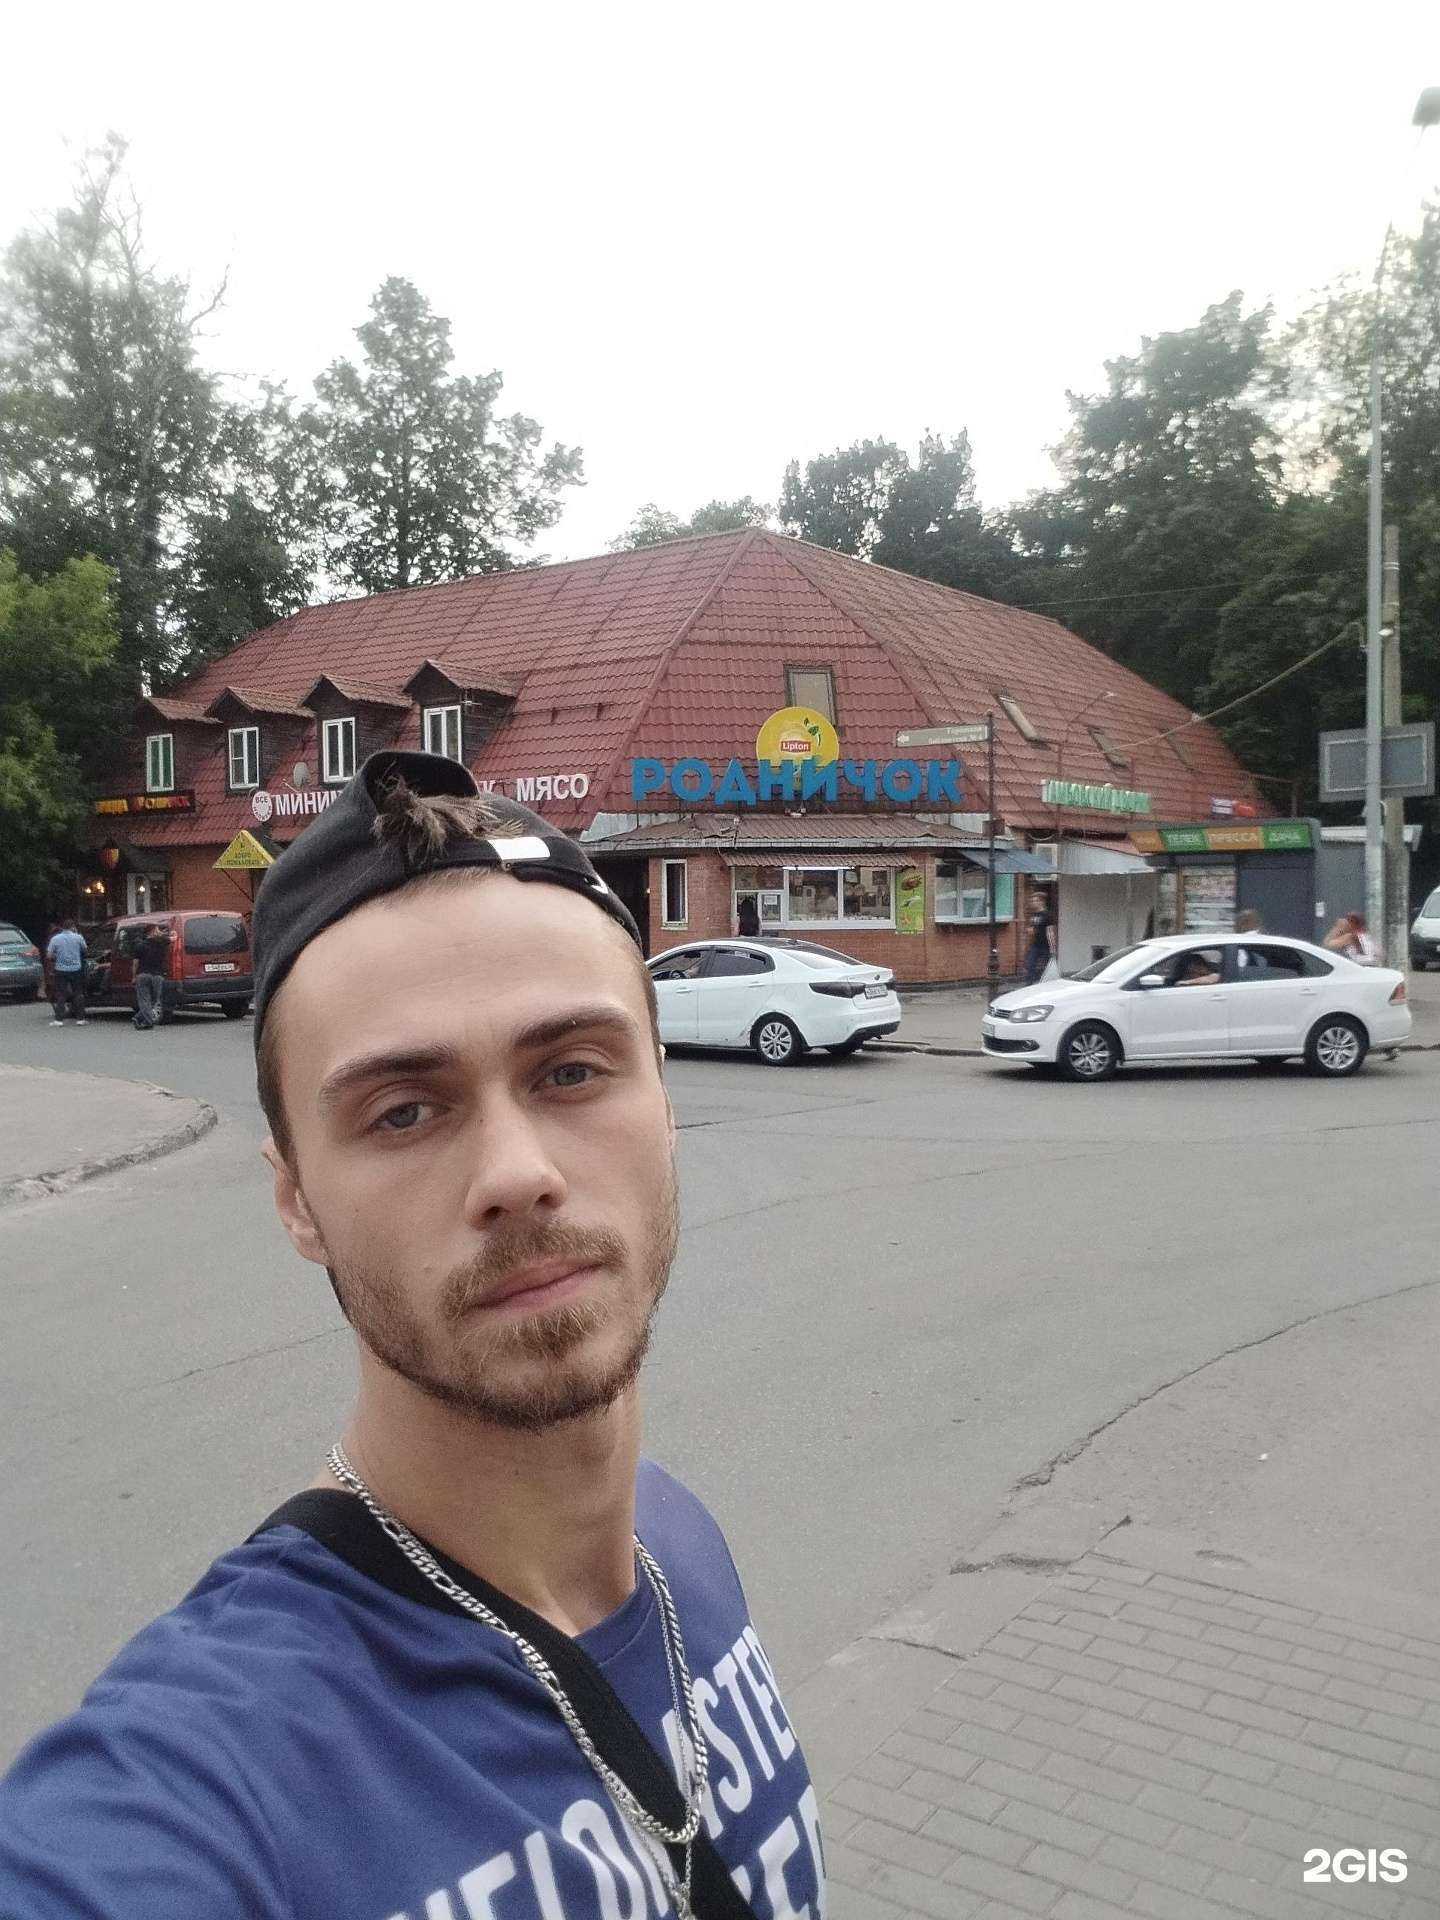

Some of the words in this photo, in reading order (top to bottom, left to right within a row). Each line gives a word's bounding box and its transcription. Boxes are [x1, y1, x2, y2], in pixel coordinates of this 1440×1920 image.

[782, 742, 809, 751] Lipton
[516, 774, 589, 802] МЯСО
[631, 757, 963, 805] РОДНИЧОК
